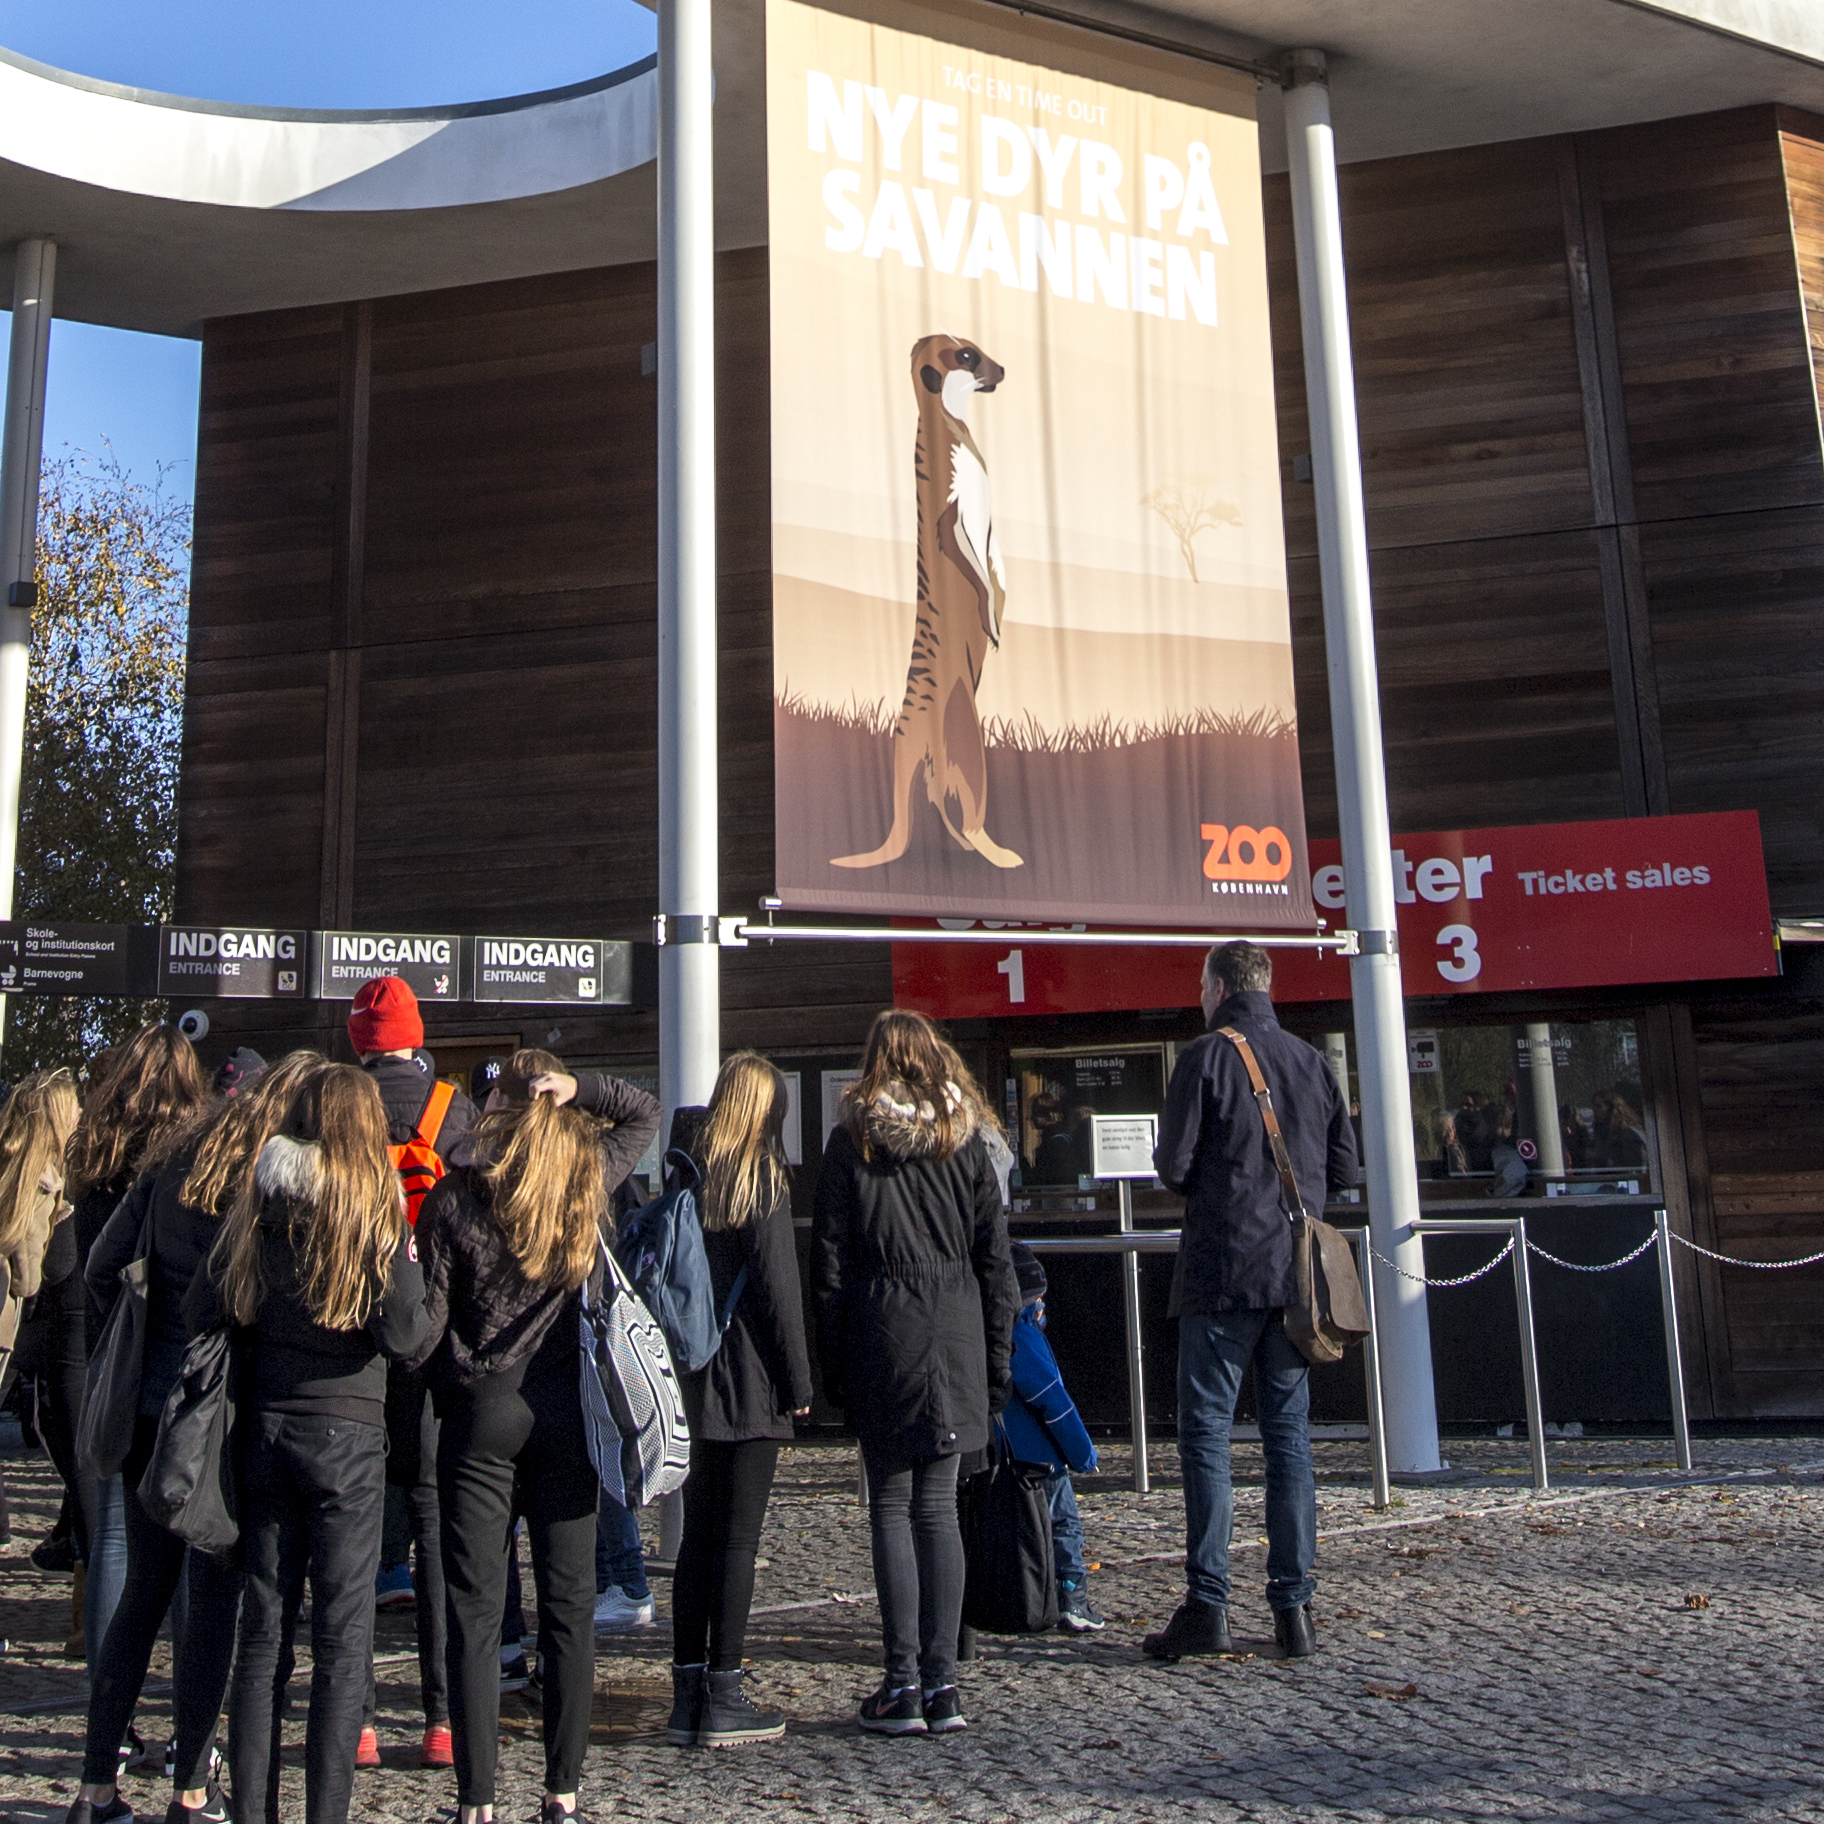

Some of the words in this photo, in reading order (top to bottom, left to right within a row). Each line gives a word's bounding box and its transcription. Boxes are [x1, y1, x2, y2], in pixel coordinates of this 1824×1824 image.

[942, 65, 982, 95] TAG
[986, 76, 1012, 99] EN
[1016, 85, 1064, 117] TIME
[1067, 100, 1108, 127] OUT
[806, 68, 959, 185] NYE
[980, 113, 1127, 224] DYR
[1144, 141, 1230, 246] PÅ
[821, 167, 1218, 328] SAVANNEN
[1212, 882, 1289, 895] KØBENHAVN
[1518, 866, 1617, 896] Ticket
[1625, 862, 1711, 889] sales
[25, 940, 39, 951] og
[41, 939, 115, 951] institutionskort
[26, 927, 59, 939] Skole-
[169, 933, 296, 959] INDGANG
[332, 937, 451, 964] INDGANG
[483, 942, 595, 968] INDGANG
[1436, 924, 1482, 983] 3
[24, 968, 84, 981] Barnevogne
[169, 962, 240, 976] ENTRANCE
[332, 966, 399, 979] ENTRANCE
[483, 970, 546, 983] ENTRANCE
[997, 949, 1026, 1004] 1
[1075, 1057, 1125, 1068] Billetsalg
